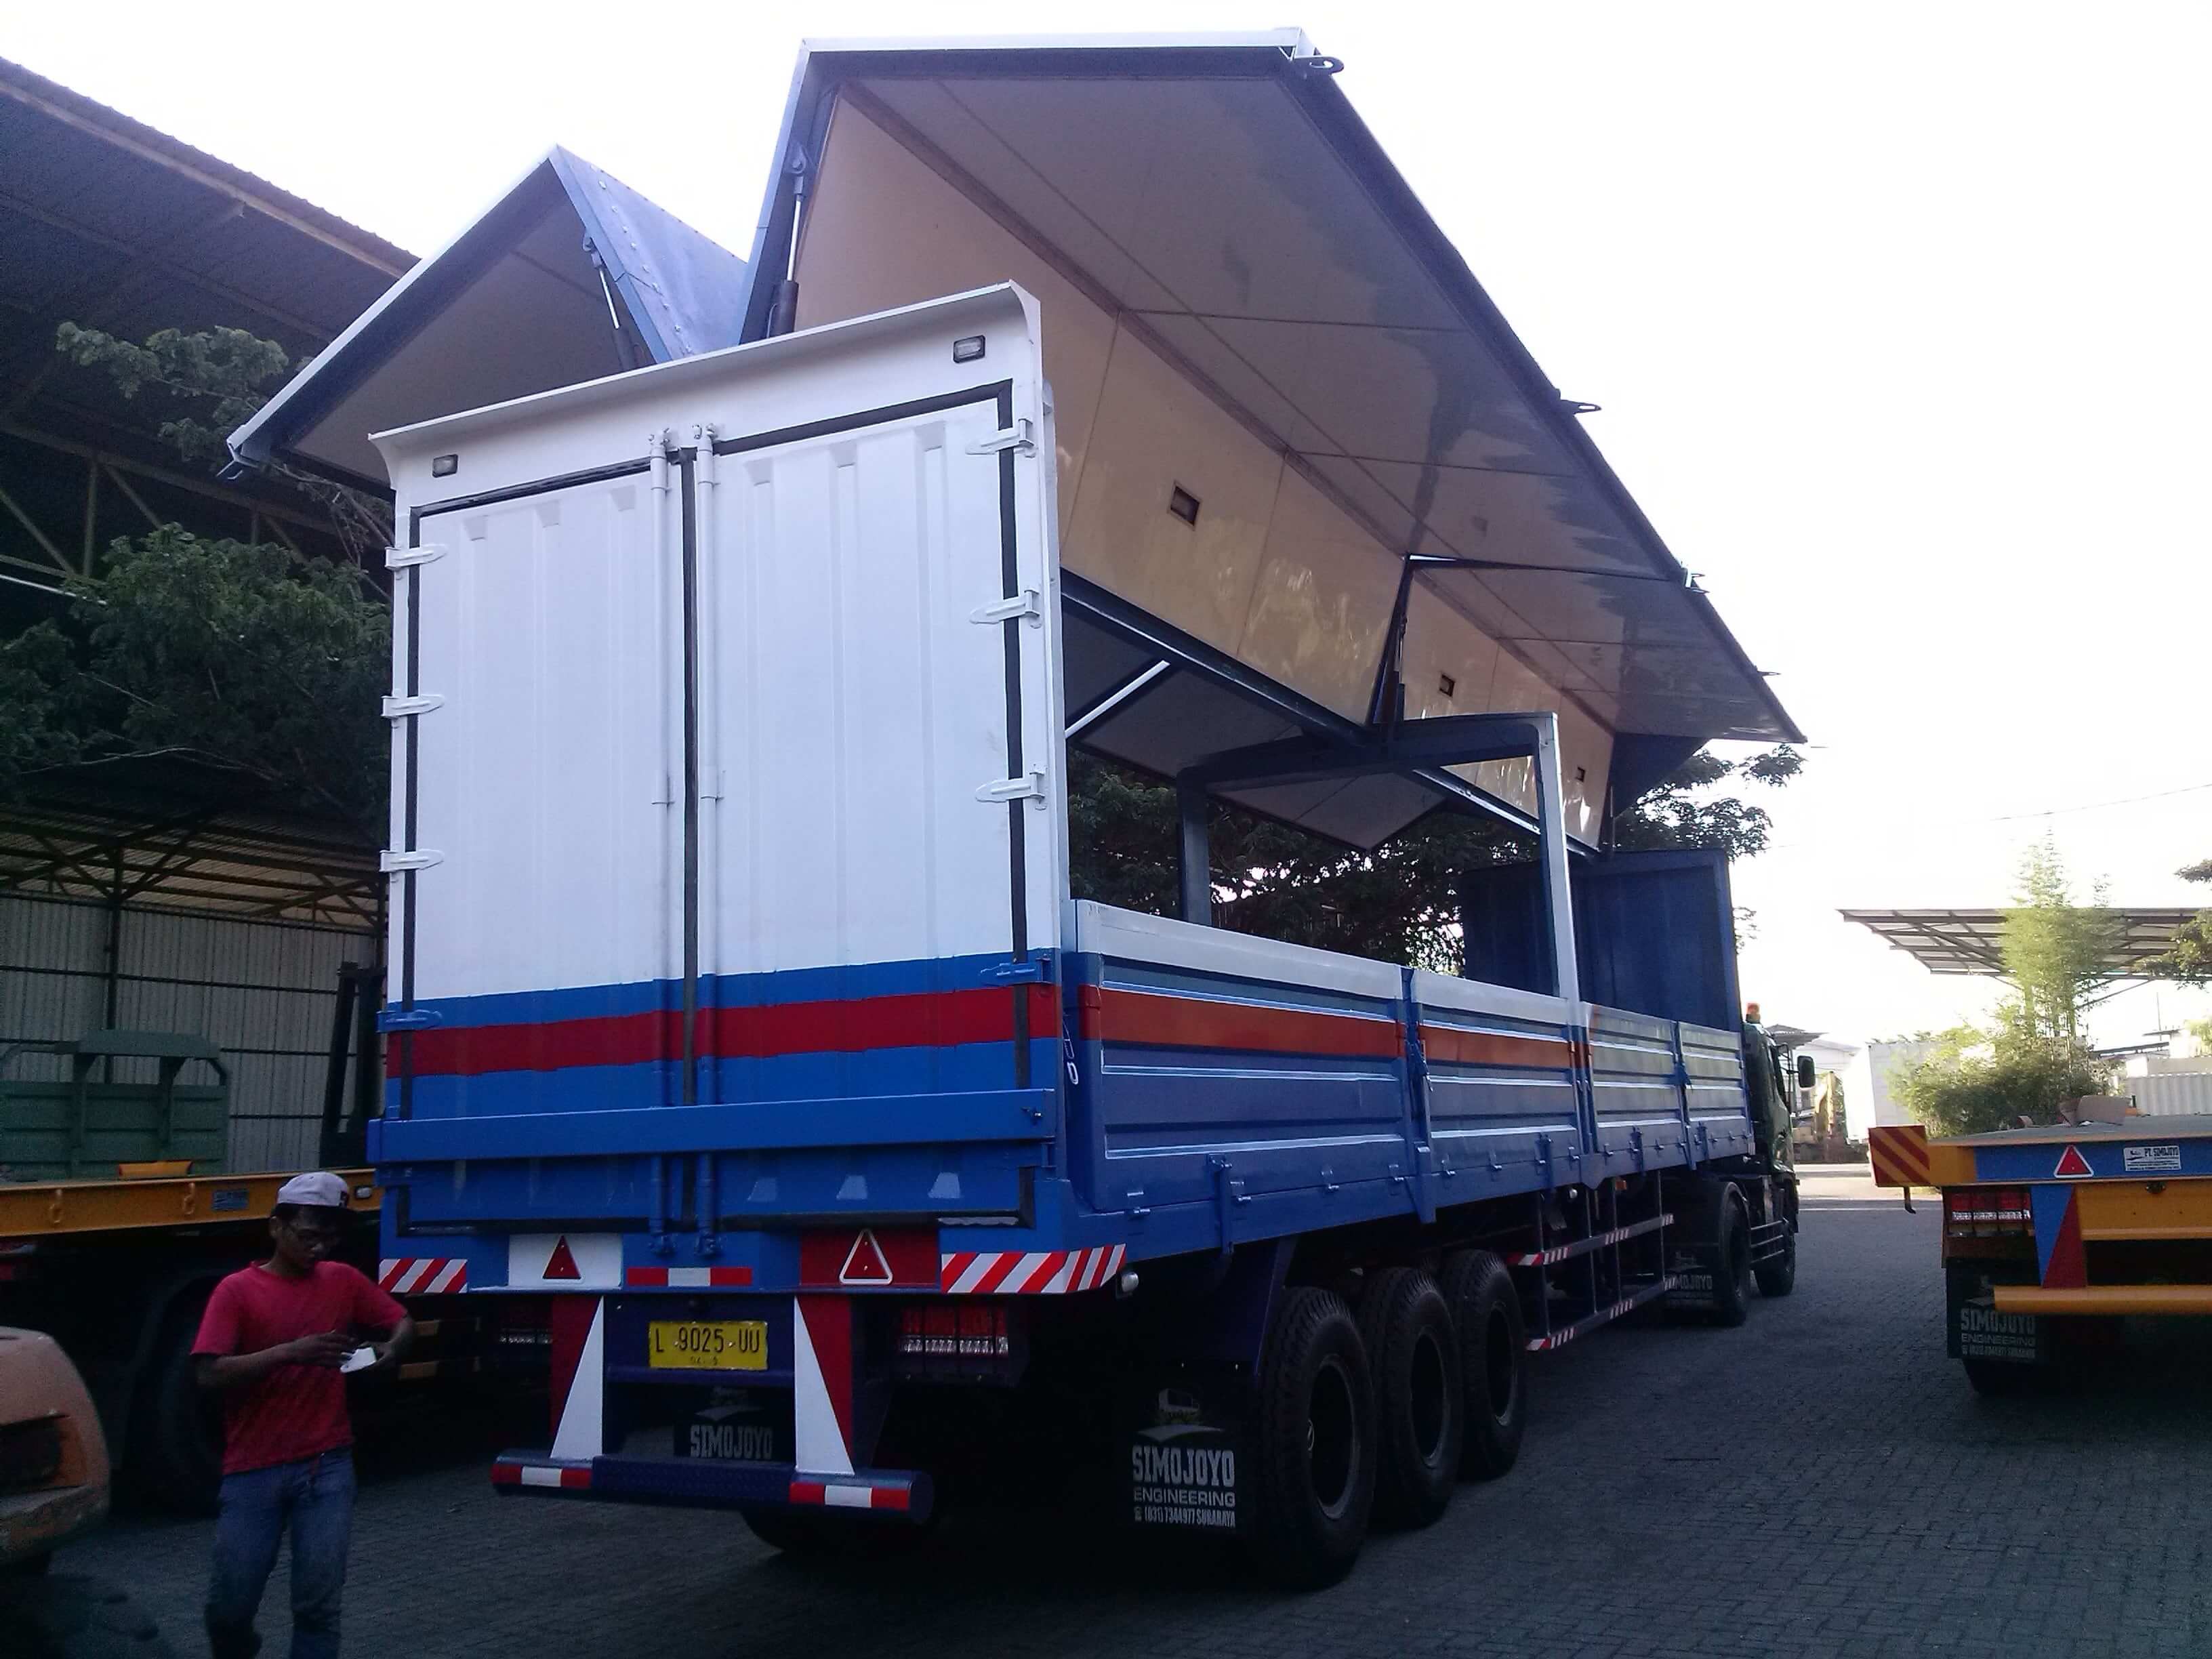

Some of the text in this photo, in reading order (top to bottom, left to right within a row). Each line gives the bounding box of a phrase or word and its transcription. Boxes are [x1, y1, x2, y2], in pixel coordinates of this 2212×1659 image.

[655, 1326, 760, 1353] L 9025 UU
[1961, 1332, 2037, 1347] ENGINEERING
[689, 1424, 774, 1460] SIMOJOYO
[1132, 1445, 1236, 1488] SIMOJOYO
[1133, 1486, 1236, 1508] ENGINEERING
[1196, 1508, 1236, 1528] SURABAYA
